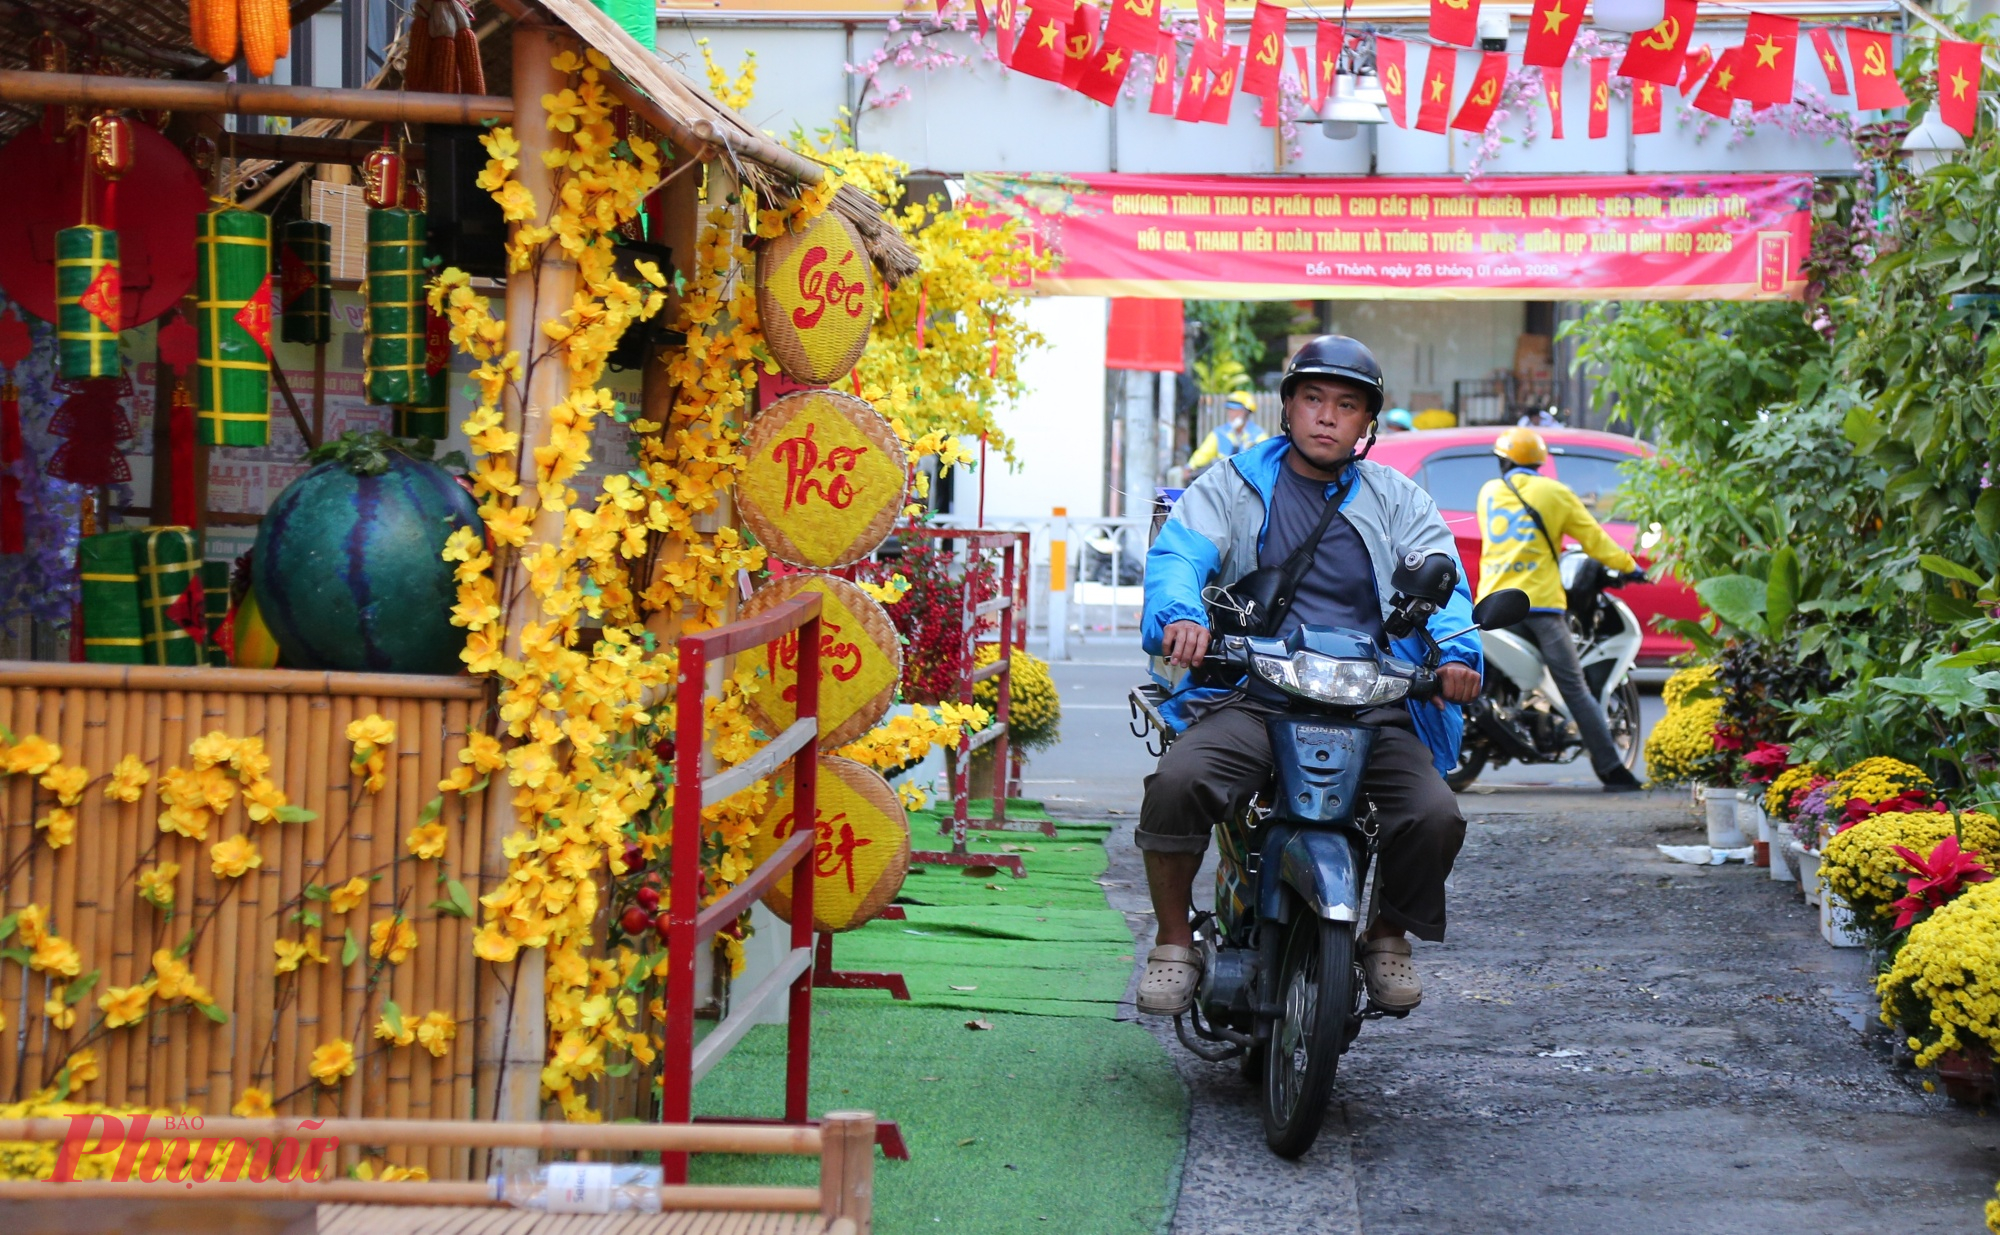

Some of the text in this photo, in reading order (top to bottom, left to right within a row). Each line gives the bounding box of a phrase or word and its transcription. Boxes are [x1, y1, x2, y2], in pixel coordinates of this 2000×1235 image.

[1112, 194, 1168, 215] CHƯƠNG
[1171, 192, 1210, 216] TRÌNH
[1214, 196, 1249, 216] TRAO
[1252, 196, 1270, 216] 64
[1314, 194, 1342, 218] QUÀ
[1349, 197, 1376, 216] CHO
[1381, 194, 1407, 217] CÁC
[1410, 194, 1430, 221] HỘ
[1433, 194, 1475, 217] THOÁT
[1478, 194, 1527, 219] NGHÈO,
[1529, 194, 1557, 217] KHÓ
[1605, 197, 1631, 217] NEO
[1164, 230, 1192, 253] GIA,
[1194, 230, 1238, 251] THANH
[1242, 226, 1273, 251] NIÊN
[1276, 227, 1313, 252] HOÀN
[1316, 227, 1361, 252] THÀNH
[1364, 227, 1382, 252] VÀ
[1385, 228, 1429, 252] TRÚNG
[1524, 227, 1561, 252] NHÂN
[1565, 232, 1587, 257] DỊP
[1591, 228, 1627, 253] XUÂN
[1630, 229, 1662, 252] BÍNH
[1666, 232, 1693, 257] NGỌ
[1696, 232, 1733, 253] 2026
[1305, 261, 1331, 275] Bến
[1381, 263, 1412, 278] ngày
[1415, 264, 1433, 276] 26
[1436, 263, 1474, 279] tháng
[1525, 264, 1559, 276] 2026
[792, 246, 865, 330] Góc
[1486, 496, 1540, 544] be
[1298, 725, 1349, 736] HONDA
